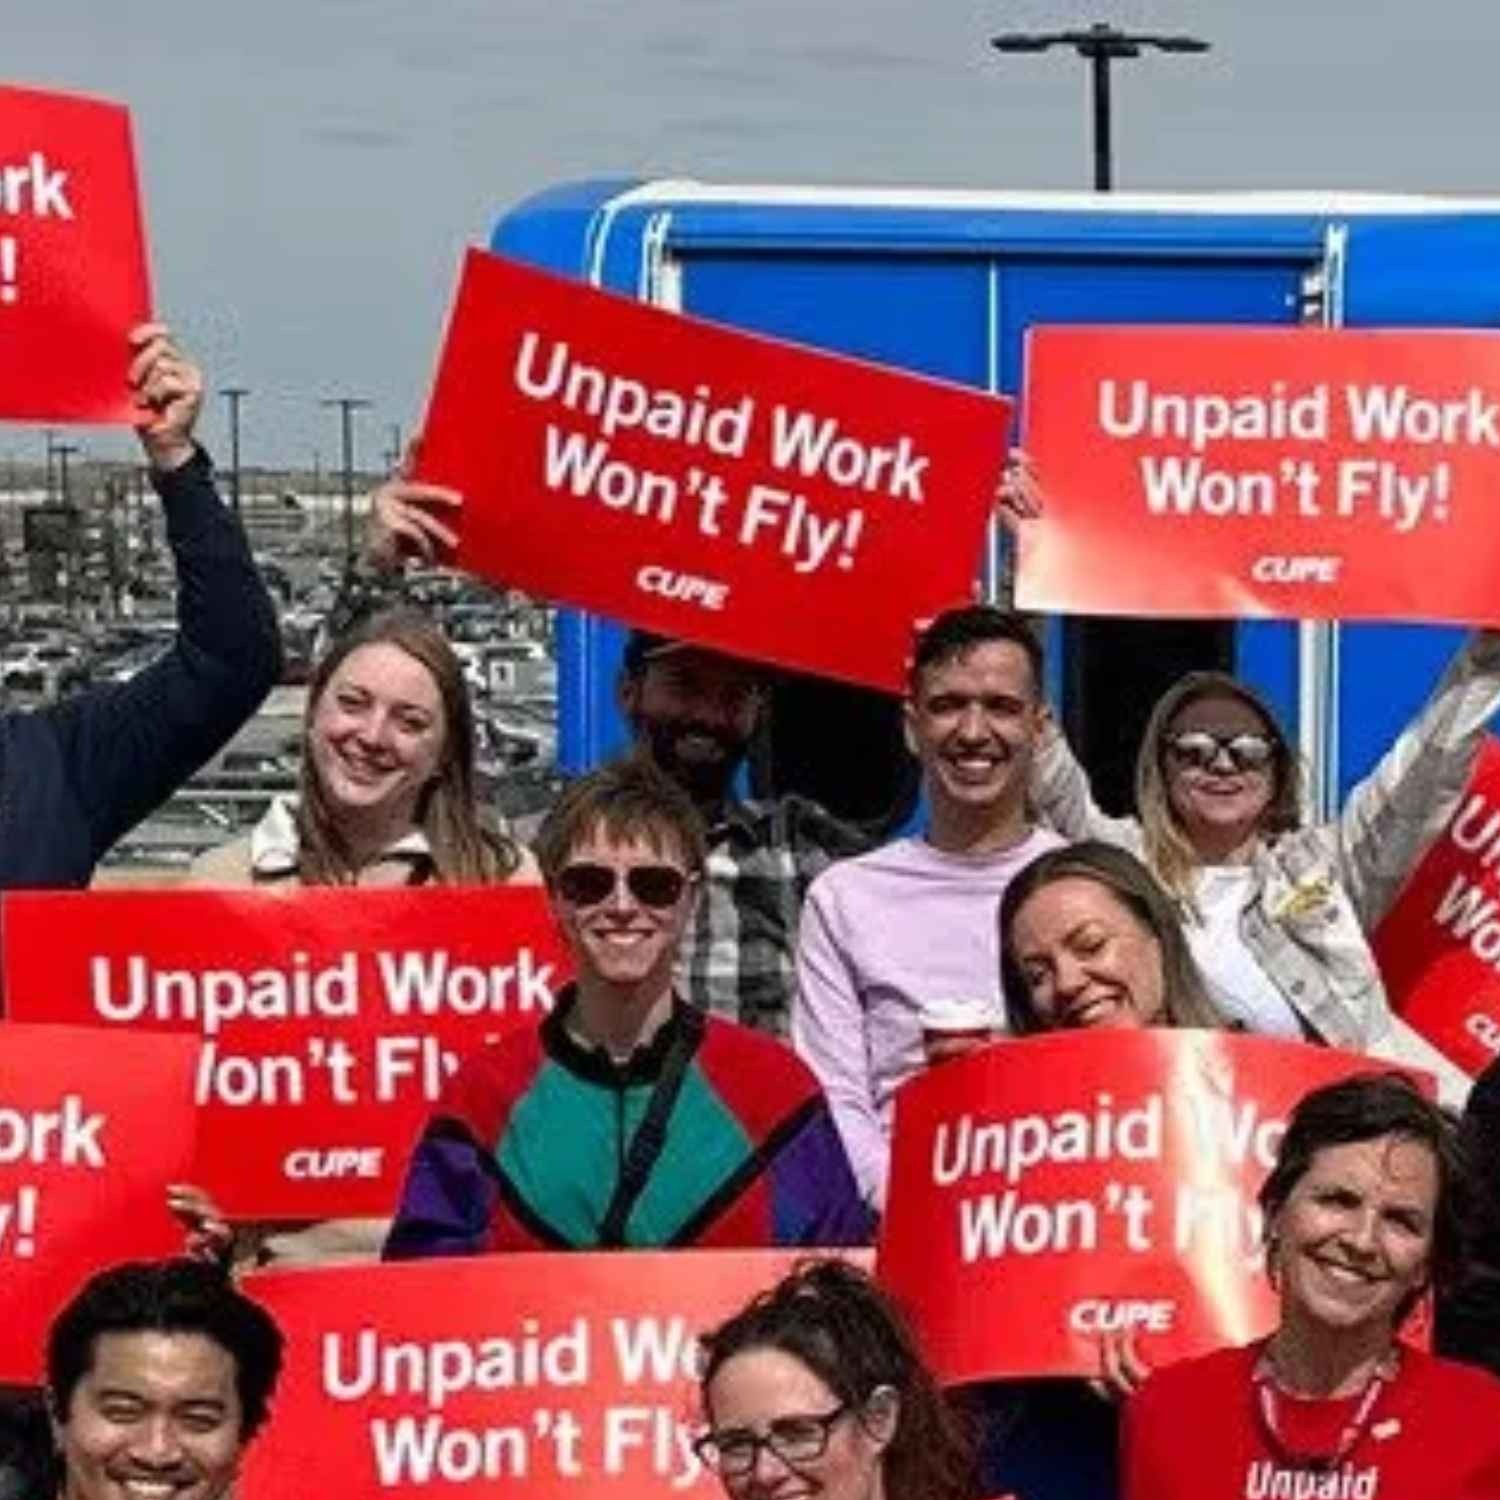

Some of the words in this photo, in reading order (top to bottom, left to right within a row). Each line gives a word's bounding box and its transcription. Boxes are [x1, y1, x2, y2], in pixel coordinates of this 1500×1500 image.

[0, 152, 74, 220] rk
[514, 332, 753, 457] Unpaid
[772, 406, 930, 502] Work
[1099, 380, 1327, 450] Unpaid
[1348, 385, 1500, 446] Work
[544, 426, 725, 534] Won't
[740, 496, 863, 575] Fly!
[1142, 456, 1319, 515] Won't
[1338, 460, 1450, 531] Fly!
[636, 565, 731, 611] CUPE
[1251, 557, 1344, 583] CUPE
[91, 953, 358, 1033] Unpaid
[381, 949, 556, 1015] Work
[0, 1096, 105, 1167] ork
[284, 1149, 383, 1179] CUPE
[932, 1094, 1162, 1187] Unpaid
[960, 1182, 1153, 1262] Won't
[1069, 1299, 1176, 1333] CUPE
[323, 1317, 590, 1407] Unpaid
[372, 1409, 583, 1486] Won't
[604, 1406, 712, 1491] Fly
